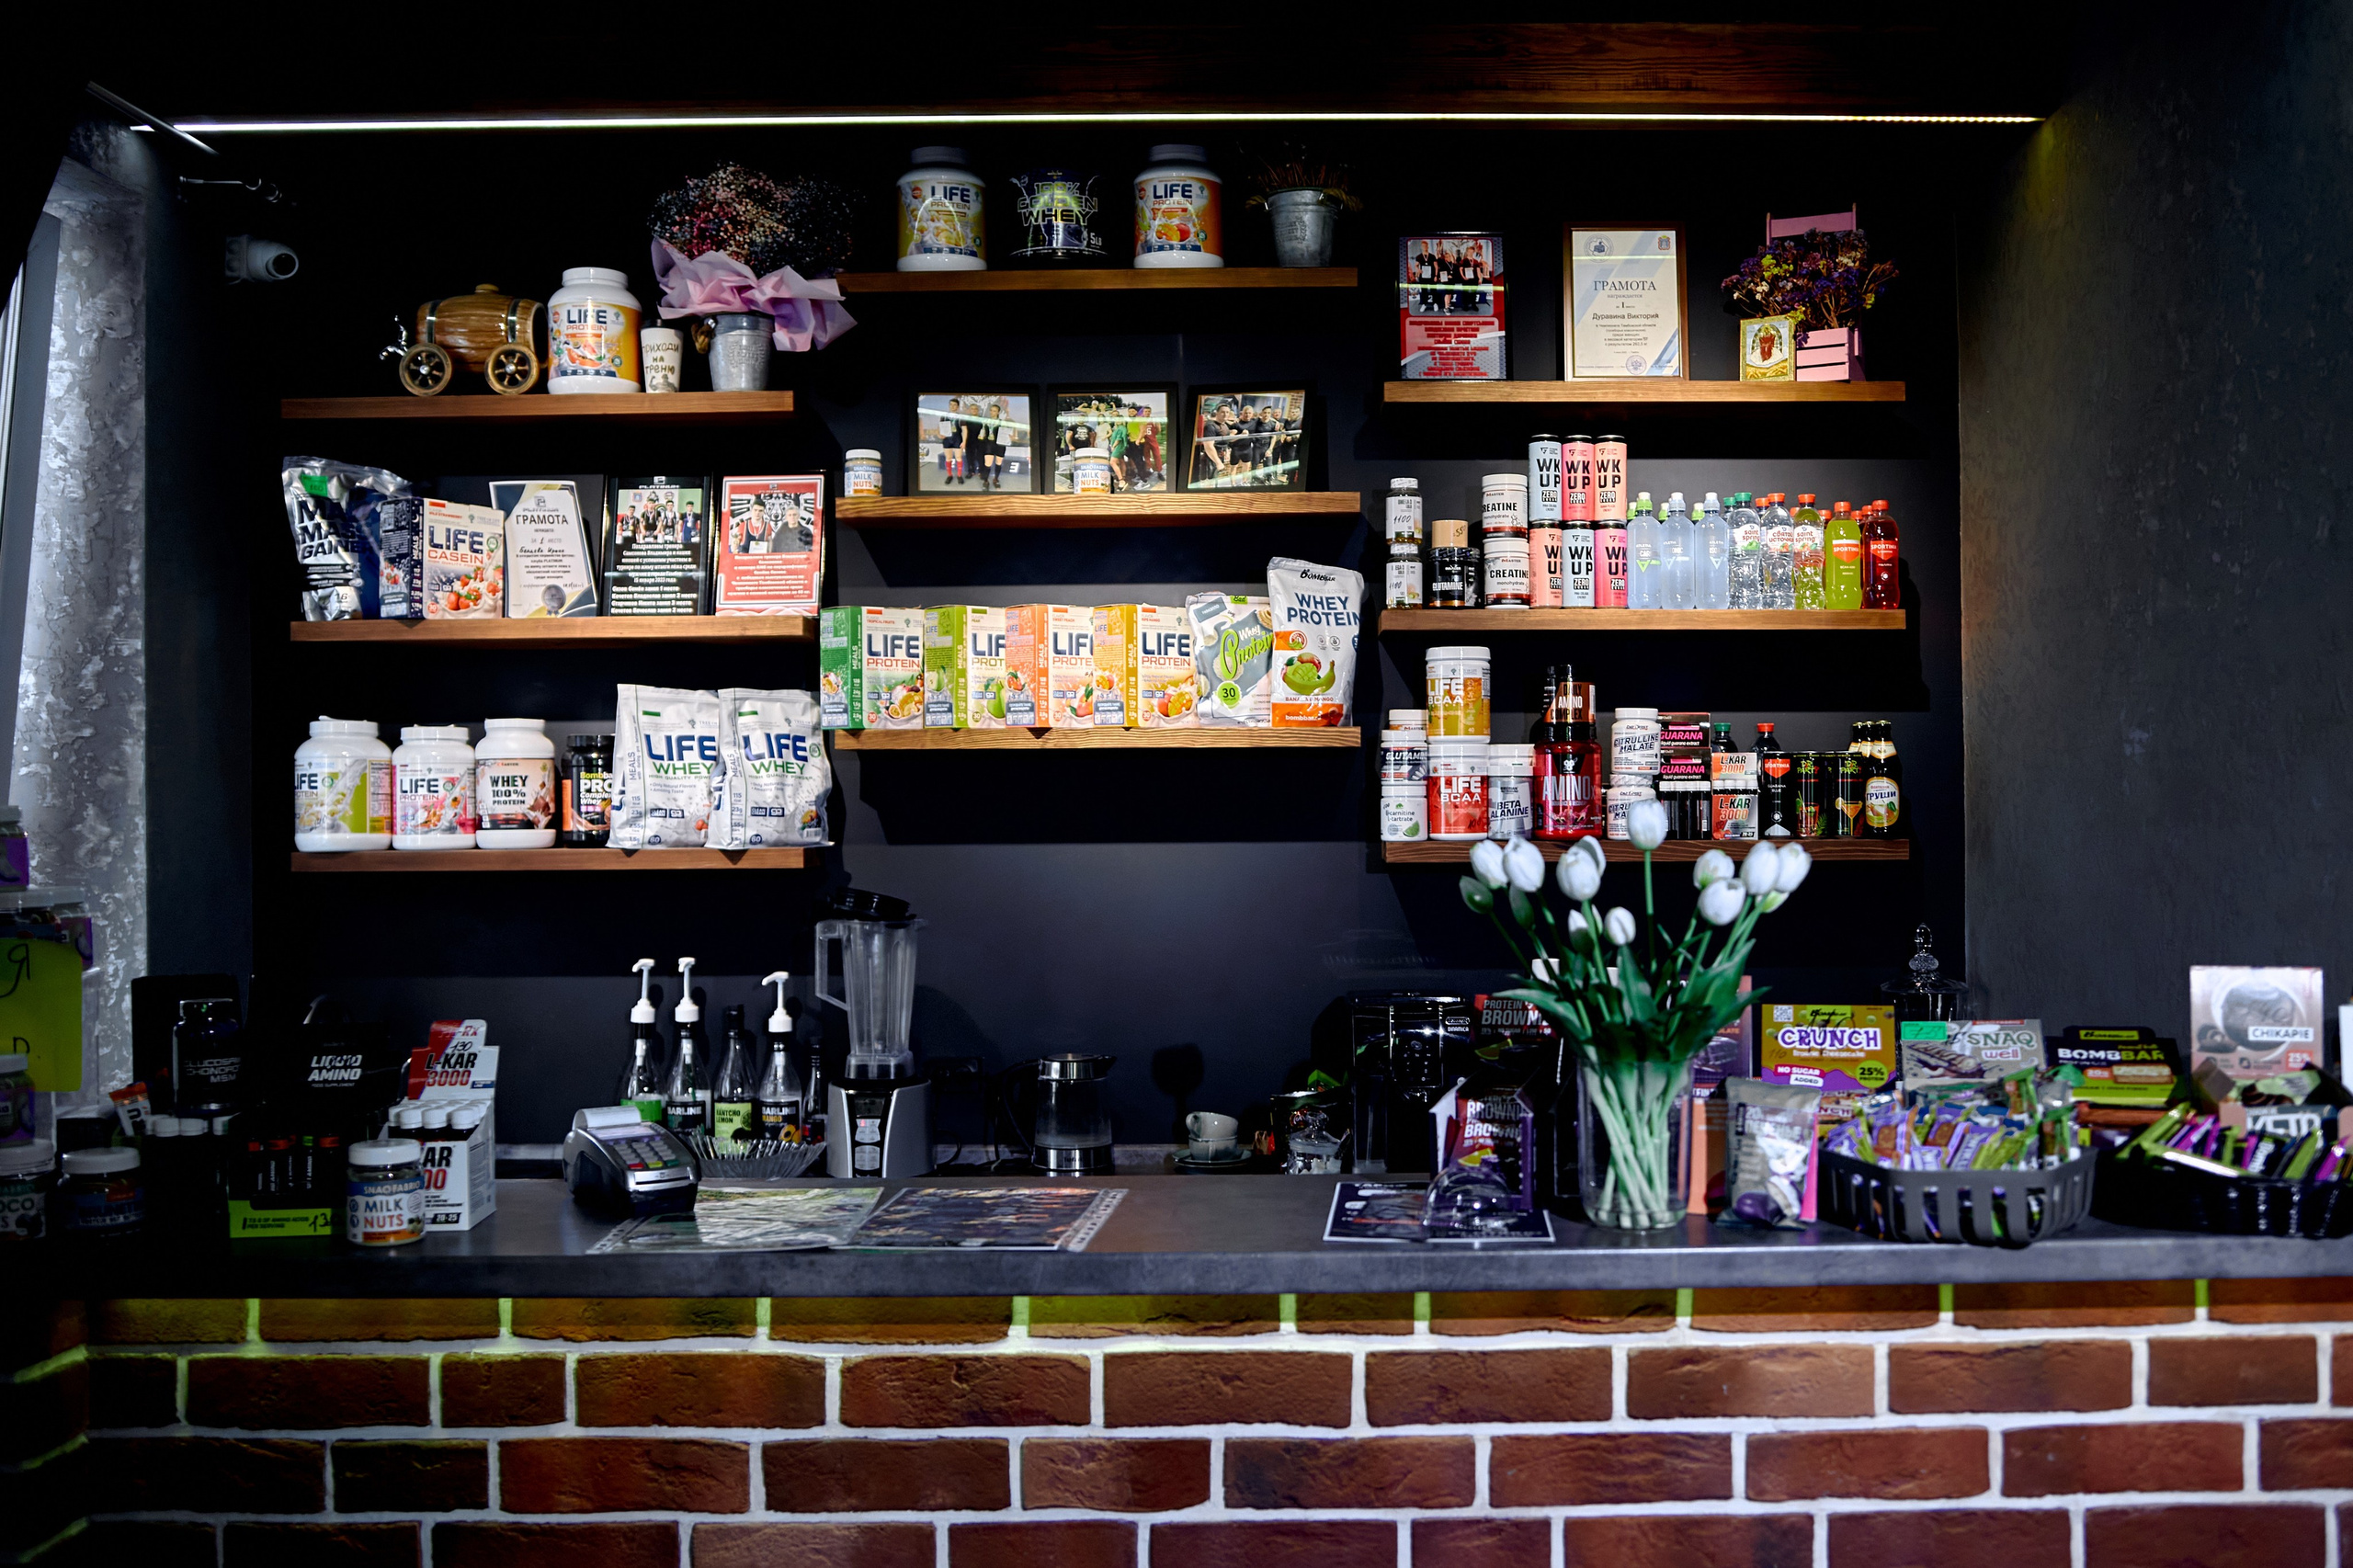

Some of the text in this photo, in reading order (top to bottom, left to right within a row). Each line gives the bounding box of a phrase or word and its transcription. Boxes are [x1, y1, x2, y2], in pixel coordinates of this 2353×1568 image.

[931, 186, 970, 203] LIFE
[1034, 182, 1079, 194] 100%
[1154, 184, 1192, 199] LIFE
[1017, 194, 1097, 211] GOLDEN
[1021, 209, 1095, 226] WHEY
[1594, 281, 1656, 290] ГРАМОТА
[567, 310, 607, 324] LIFE
[1537, 459, 1560, 473] WK
[1565, 460, 1590, 474] WK
[1597, 460, 1620, 473] WK
[1540, 474, 1560, 487] UP
[1567, 476, 1590, 489] UP
[1598, 474, 1620, 488] UP
[516, 515, 568, 525] ГРАМОТА
[428, 526, 483, 554] LIFE
[1743, 535, 1760, 543] spring
[427, 549, 483, 564] CASEIN
[1569, 547, 1592, 560] WK
[1606, 547, 1627, 560] WK
[1490, 570, 1529, 579] CREATINE
[1572, 562, 1593, 575] UP
[1608, 562, 1627, 575] UP
[1295, 593, 1349, 611] WHEY
[1287, 607, 1361, 627] PROTEIN
[1239, 625, 1260, 642] Whey
[867, 633, 920, 659] LIFE
[972, 632, 1006, 658] LIF
[1053, 632, 1093, 657] LIF
[1142, 632, 1190, 657] LIFE
[867, 658, 920, 668] PROTEIN
[1142, 656, 1191, 667] PROTEIN
[1222, 688, 1236, 699] 30
[1427, 680, 1463, 699] LIFE
[1427, 697, 1464, 705] BCAA
[1558, 697, 1583, 709] AMINO
[1613, 733, 1659, 748] CITRULLINE
[1660, 731, 1704, 741] GUARANA
[644, 733, 716, 762] LIFE
[742, 733, 809, 762] LIFE
[1620, 743, 1654, 755] MALATE
[629, 752, 637, 781] MEALS
[727, 753, 739, 778] MEALS
[1721, 756, 1746, 766] L-KAR
[653, 761, 714, 776] WHEY
[751, 760, 805, 776] WHEY
[1661, 765, 1705, 774] GUARANA
[1722, 765, 1745, 773] 3000
[295, 773, 318, 790] IFE
[400, 778, 439, 793] LIFE
[490, 776, 529, 788] WHEY
[1440, 777, 1482, 793] LIFE
[400, 794, 439, 802] PROTEIN
[492, 790, 527, 801] 100%
[1440, 793, 1482, 802] BCAA
[1866, 791, 1897, 801] ГРУШИ
[580, 799, 603, 807] Whey
[1497, 801, 1521, 810] BETA
[1720, 799, 1751, 811] L-KAR
[1490, 807, 1529, 819] ALANINE
[1721, 809, 1749, 820] 3000
[1483, 999, 1524, 1010] PROTEIN
[1779, 1028, 1881, 1050] CRUNCH
[1967, 1031, 2035, 1048] SNAQ
[2251, 1028, 2310, 1040] CHIKAPIE
[449, 1041, 472, 1053] 130
[1984, 1048, 2019, 1060] well
[2057, 1048, 2165, 1062] BOMBBAR
[2287, 1051, 2311, 1062] 25%
[425, 1052, 477, 1070] L-KAR
[307, 1068, 363, 1083] AMINO
[1777, 1066, 1821, 1076] NO SUGAR
[1859, 1067, 1885, 1076] 25%
[426, 1070, 471, 1087] 3000
[1794, 1076, 1820, 1085] ADDED
[667, 1106, 702, 1116] BARLINE
[762, 1106, 797, 1116] BARLINE
[364, 1198, 403, 1214] MILK
[364, 1214, 404, 1229] NUTS
